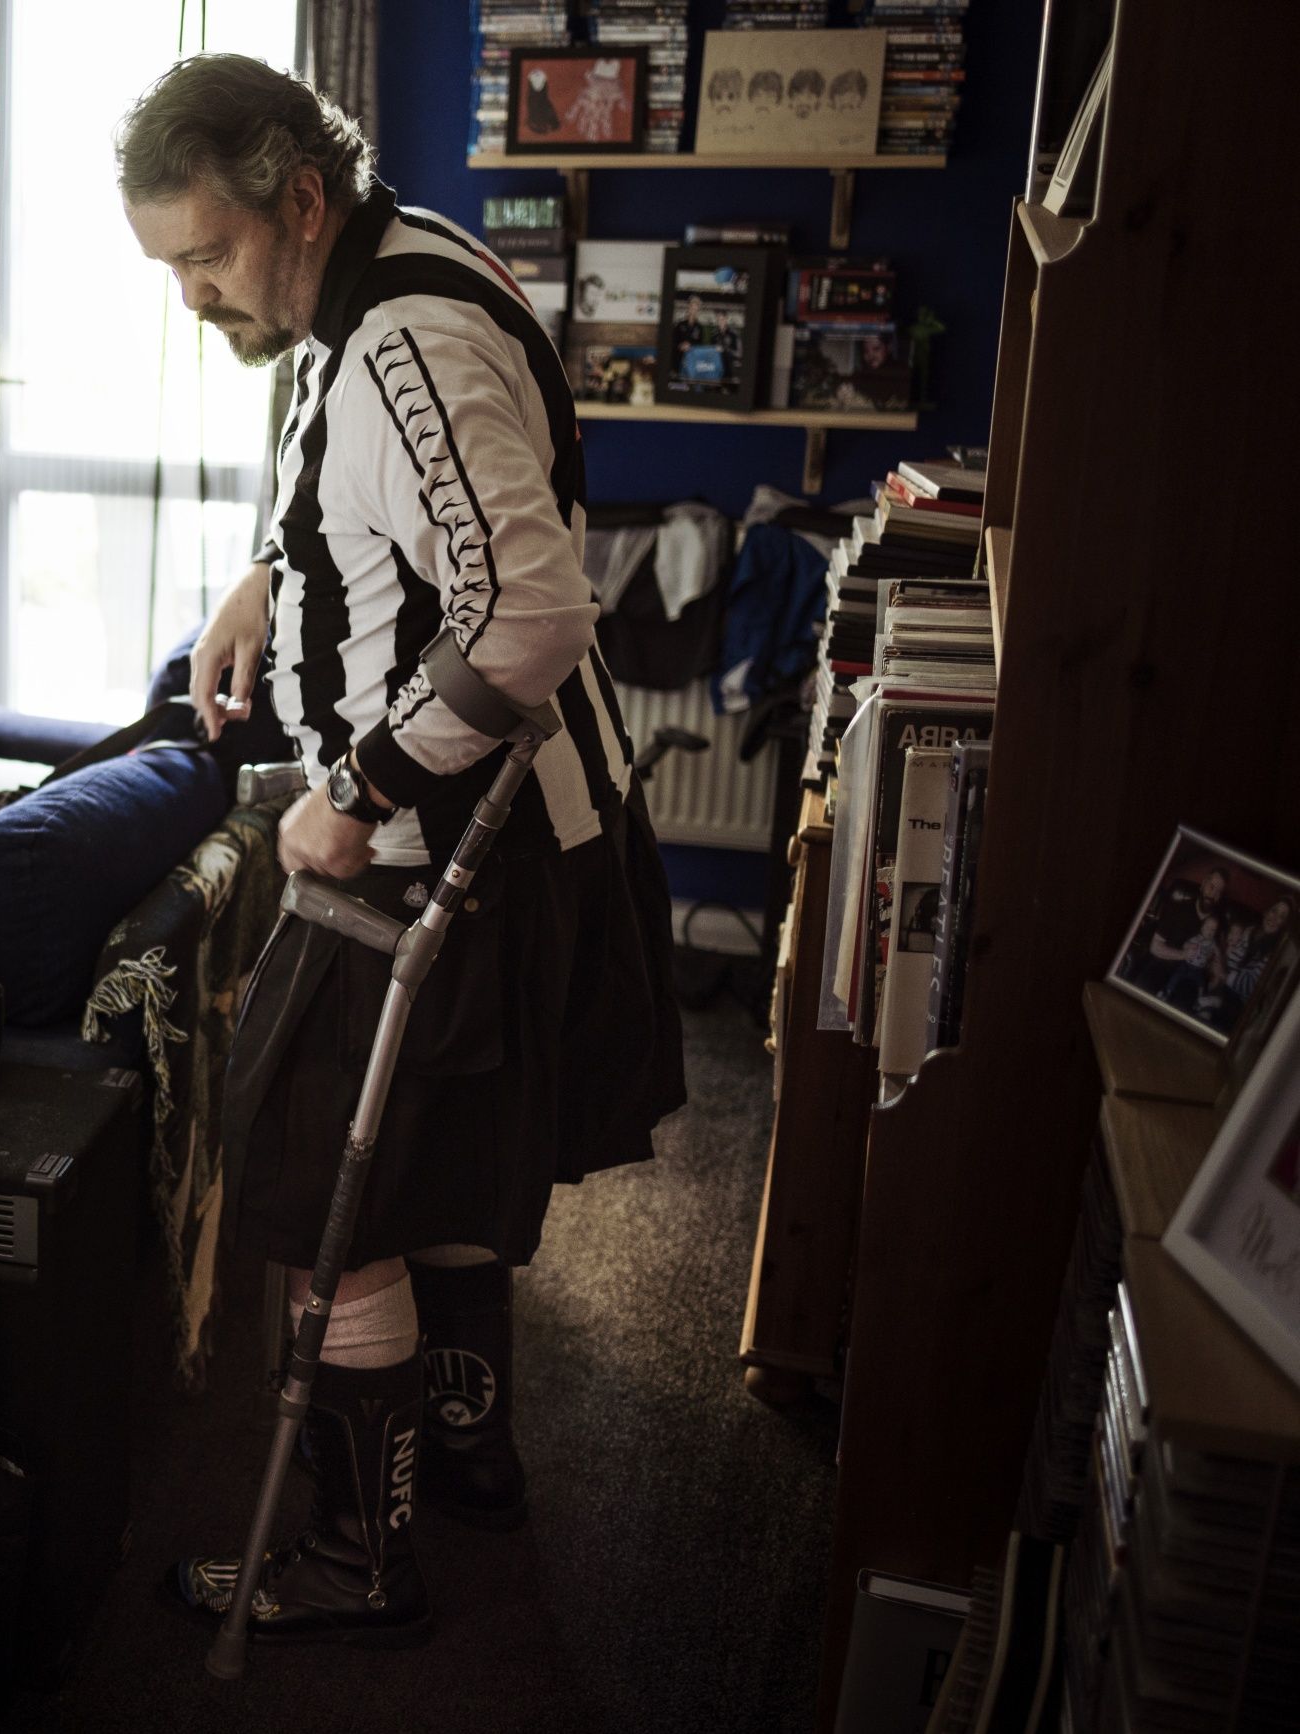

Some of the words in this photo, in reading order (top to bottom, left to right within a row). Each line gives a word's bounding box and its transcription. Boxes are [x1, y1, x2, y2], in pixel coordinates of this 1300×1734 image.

[897, 723, 977, 749] ABBA
[908, 818, 941, 831] The
[389, 1427, 416, 1530] NUFC
